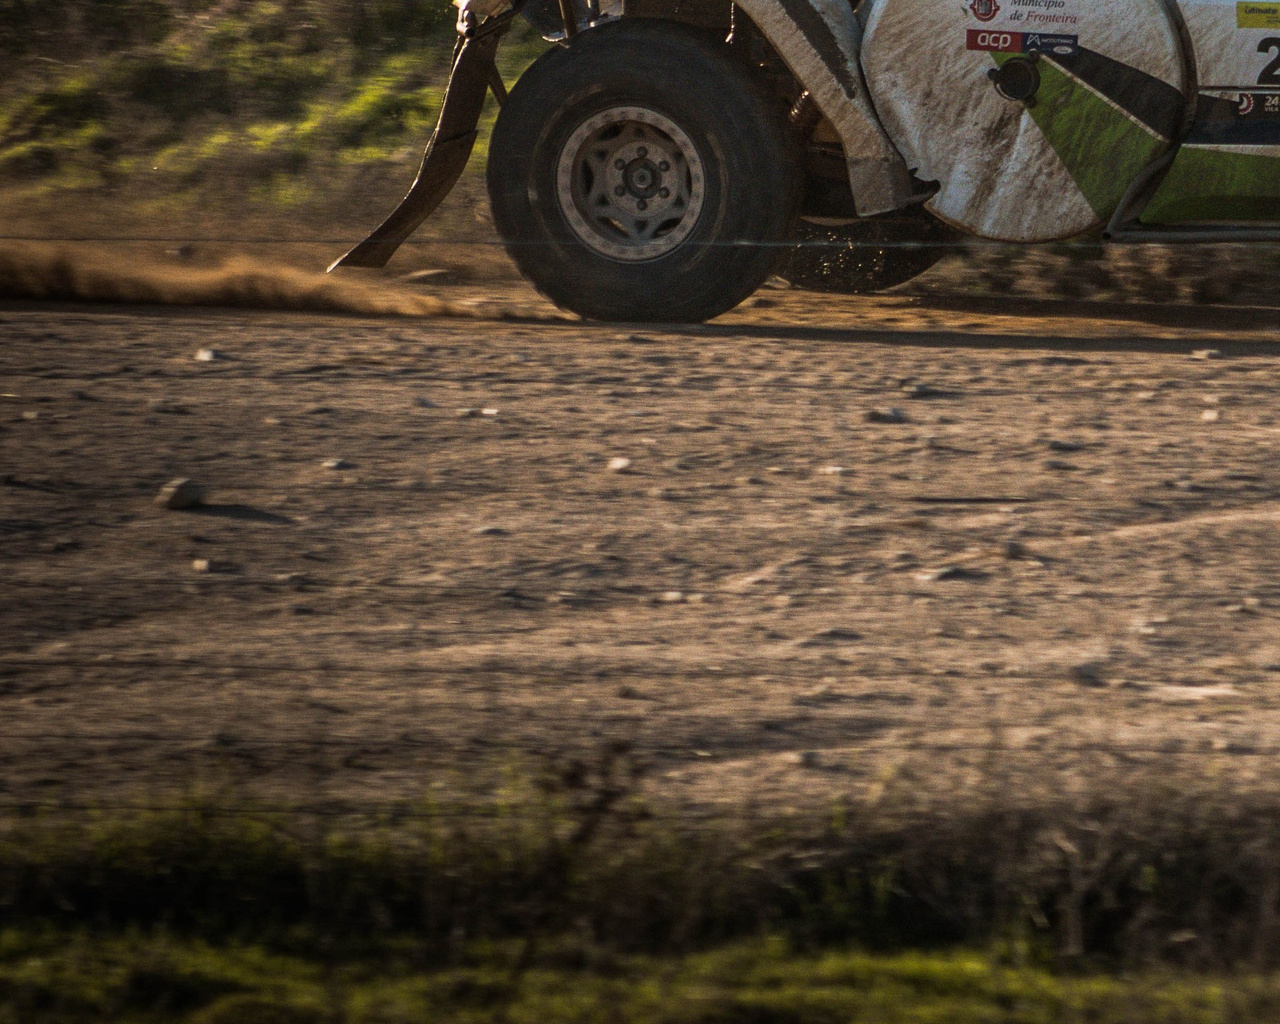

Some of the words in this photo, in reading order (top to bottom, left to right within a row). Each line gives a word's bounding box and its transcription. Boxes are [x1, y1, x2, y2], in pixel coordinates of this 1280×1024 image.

[1009, 10, 1023, 21] de
[1025, 10, 1077, 24] Fronteira
[977, 33, 1011, 49] acp
